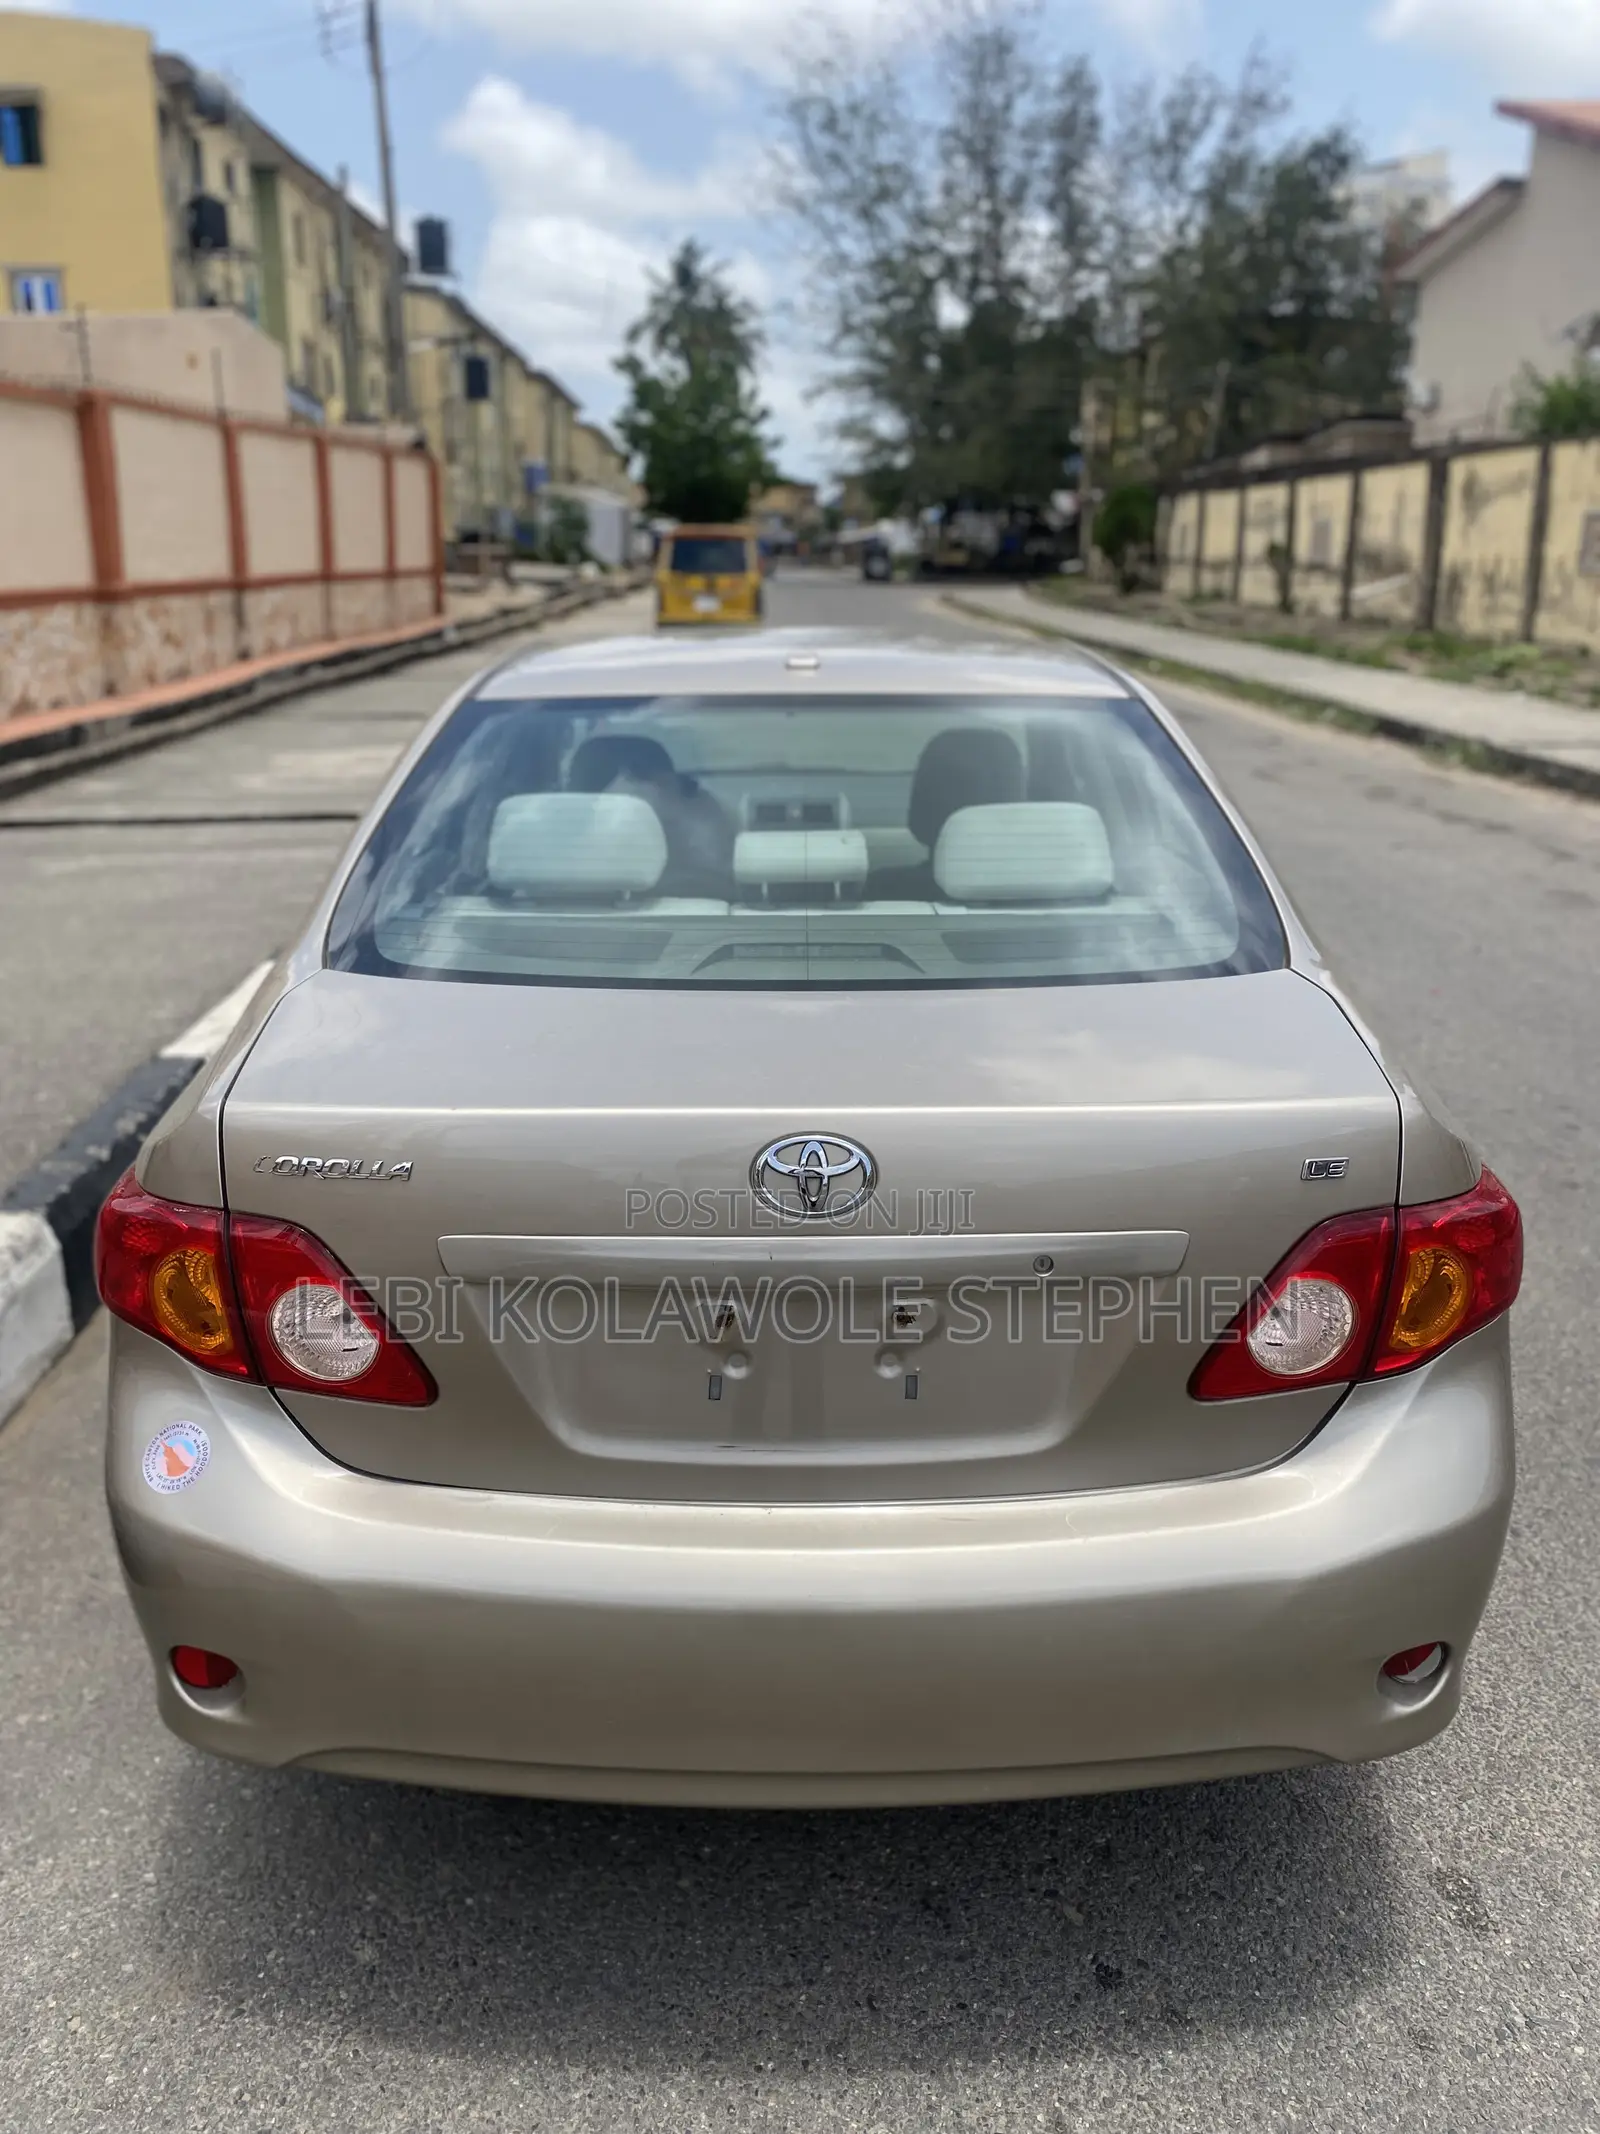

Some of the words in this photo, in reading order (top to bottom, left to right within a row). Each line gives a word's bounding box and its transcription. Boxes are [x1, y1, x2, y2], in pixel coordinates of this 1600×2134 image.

[253, 1155, 414, 1181] COROLLA
[1308, 1160, 1347, 1178] LE
[159, 1424, 187, 1436] NATIONAL
[188, 1424, 203, 1436] PARK
[145, 1437, 159, 1461] CANYON
[145, 1463, 153, 1482] BRYCE
[182, 1476, 197, 1488] THE
[195, 1440, 209, 1477] HOODOOS!
